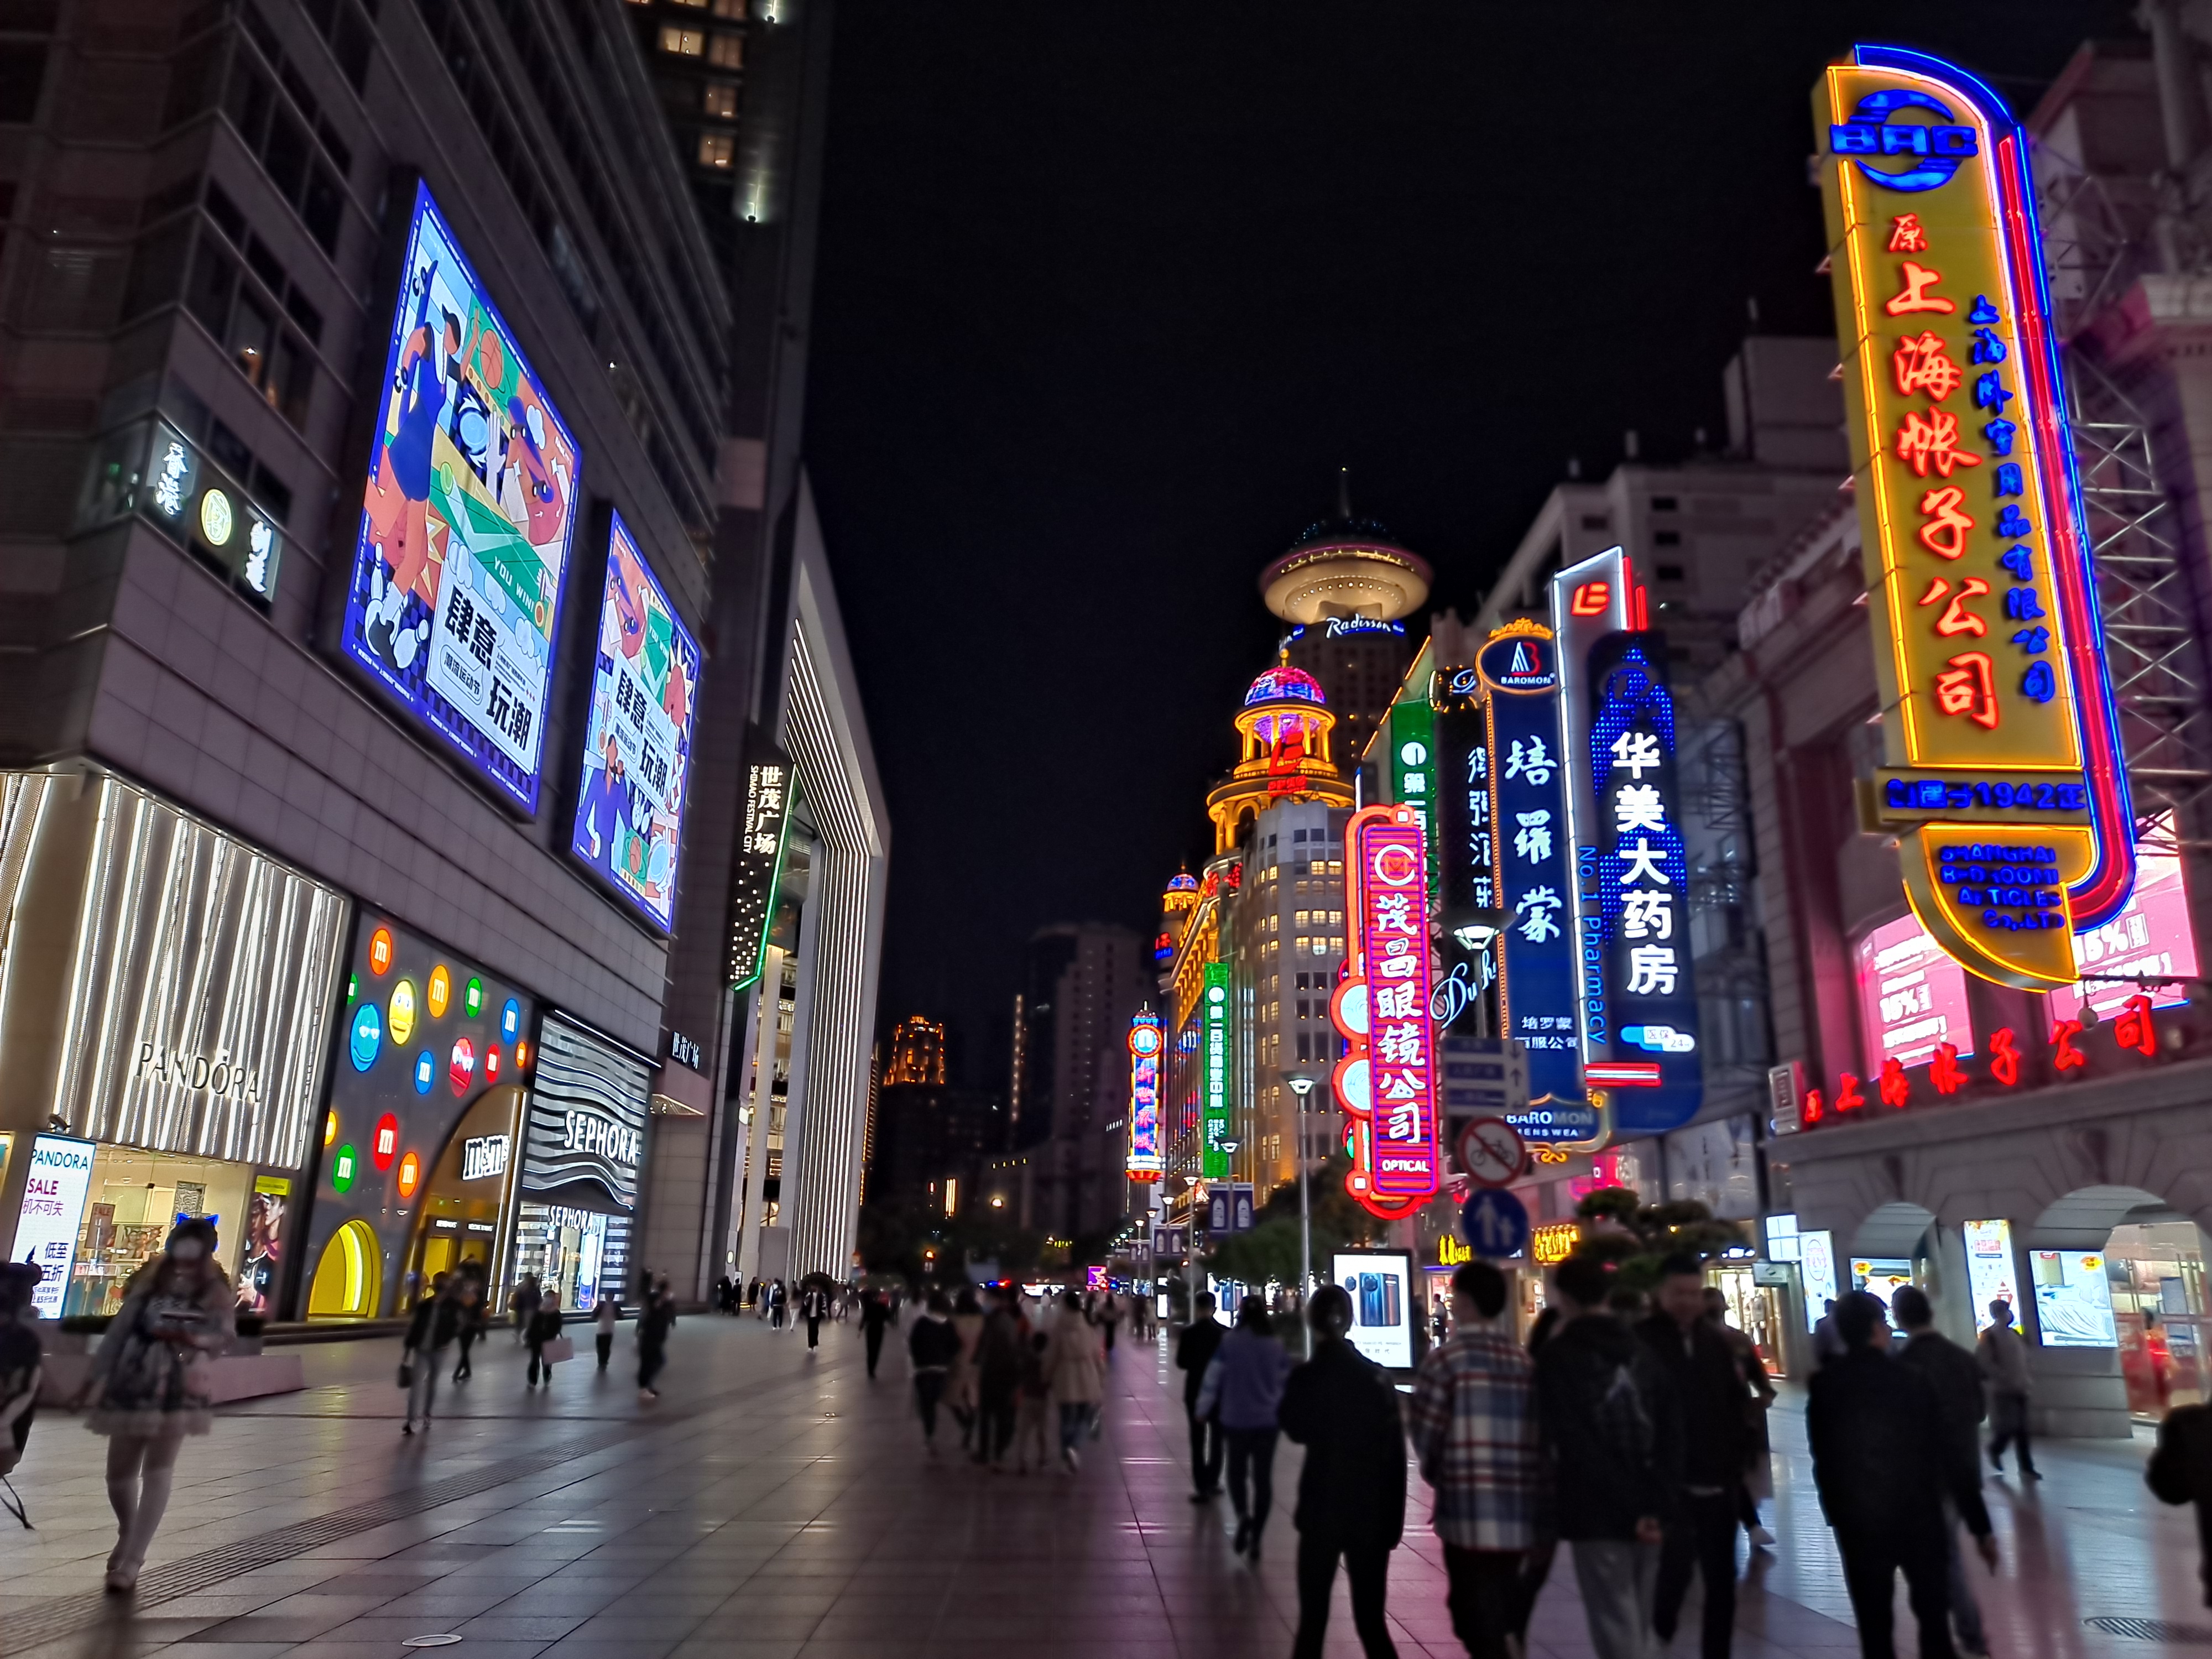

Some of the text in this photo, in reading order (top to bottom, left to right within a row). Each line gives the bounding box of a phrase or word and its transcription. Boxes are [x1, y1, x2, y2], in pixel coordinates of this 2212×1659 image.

[1830, 124, 1978, 156] BAC
[493, 556, 513, 587] YOU
[445, 584, 497, 671] 肆意
[1326, 613, 1391, 639] Radisson
[616, 667, 647, 734] 肆意
[1501, 676, 1551, 685] BAROMON
[486, 675, 533, 751] 玩潮
[639, 737, 668, 798] 玩潮
[743, 765, 759, 855] SHIMAO FESTIVAL CITY
[753, 765, 783, 855] 世茂广场
[1610, 731, 1678, 995] 华美大药房
[1940, 843, 2056, 863] SHANGHAI
[1583, 917, 1606, 1045] Pharmacy
[1375, 893, 1426, 1144] 茂昌眼镜公司
[564, 1110, 637, 1164] SEPHORA
[32, 1149, 88, 1170] PANDORA
[1382, 1159, 1430, 1173] OPTICAL
[28, 1178, 59, 1196] SALE
[549, 1205, 593, 1230] SEPHORA
[45, 1242, 69, 1259] 低至
